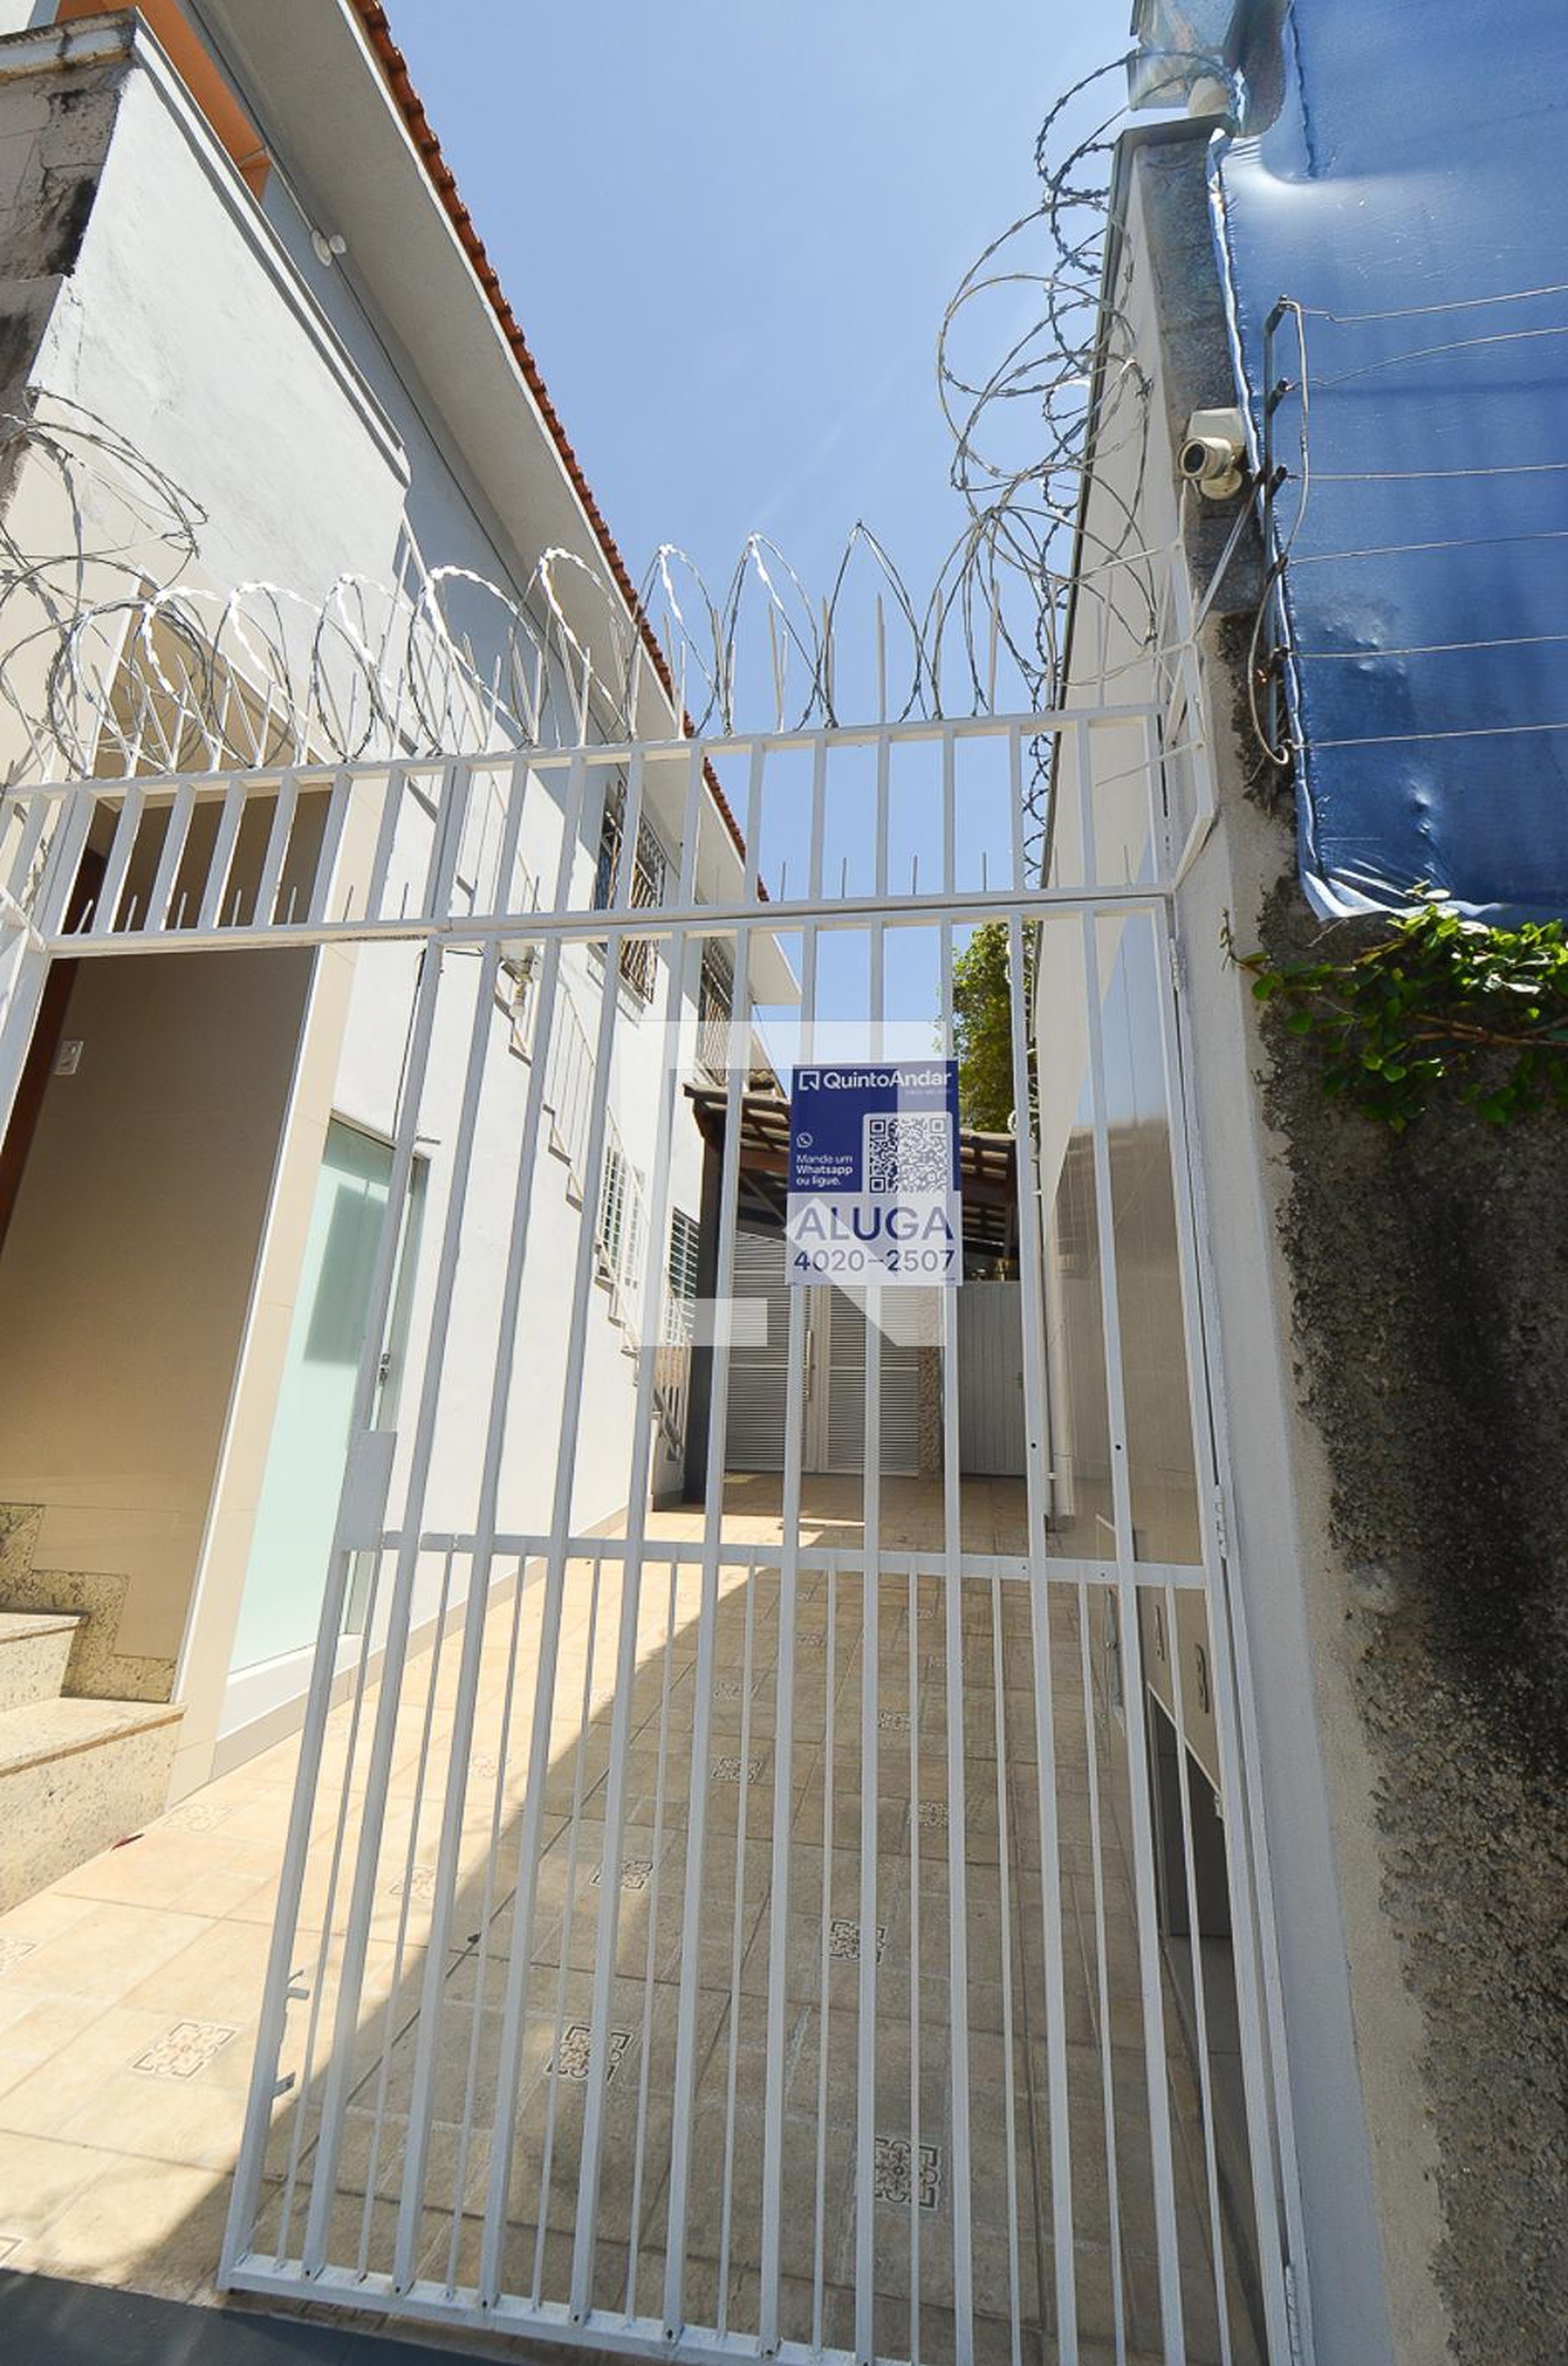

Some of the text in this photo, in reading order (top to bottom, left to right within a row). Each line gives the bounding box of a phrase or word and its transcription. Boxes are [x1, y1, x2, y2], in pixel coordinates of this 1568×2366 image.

[823, 1070, 952, 1089] QuintoAndar
[796, 1154, 853, 1164] Mande um
[796, 1164, 853, 1176] Whatsapp
[796, 1176, 810, 1185] ou
[795, 1206, 955, 1241] ALUGA
